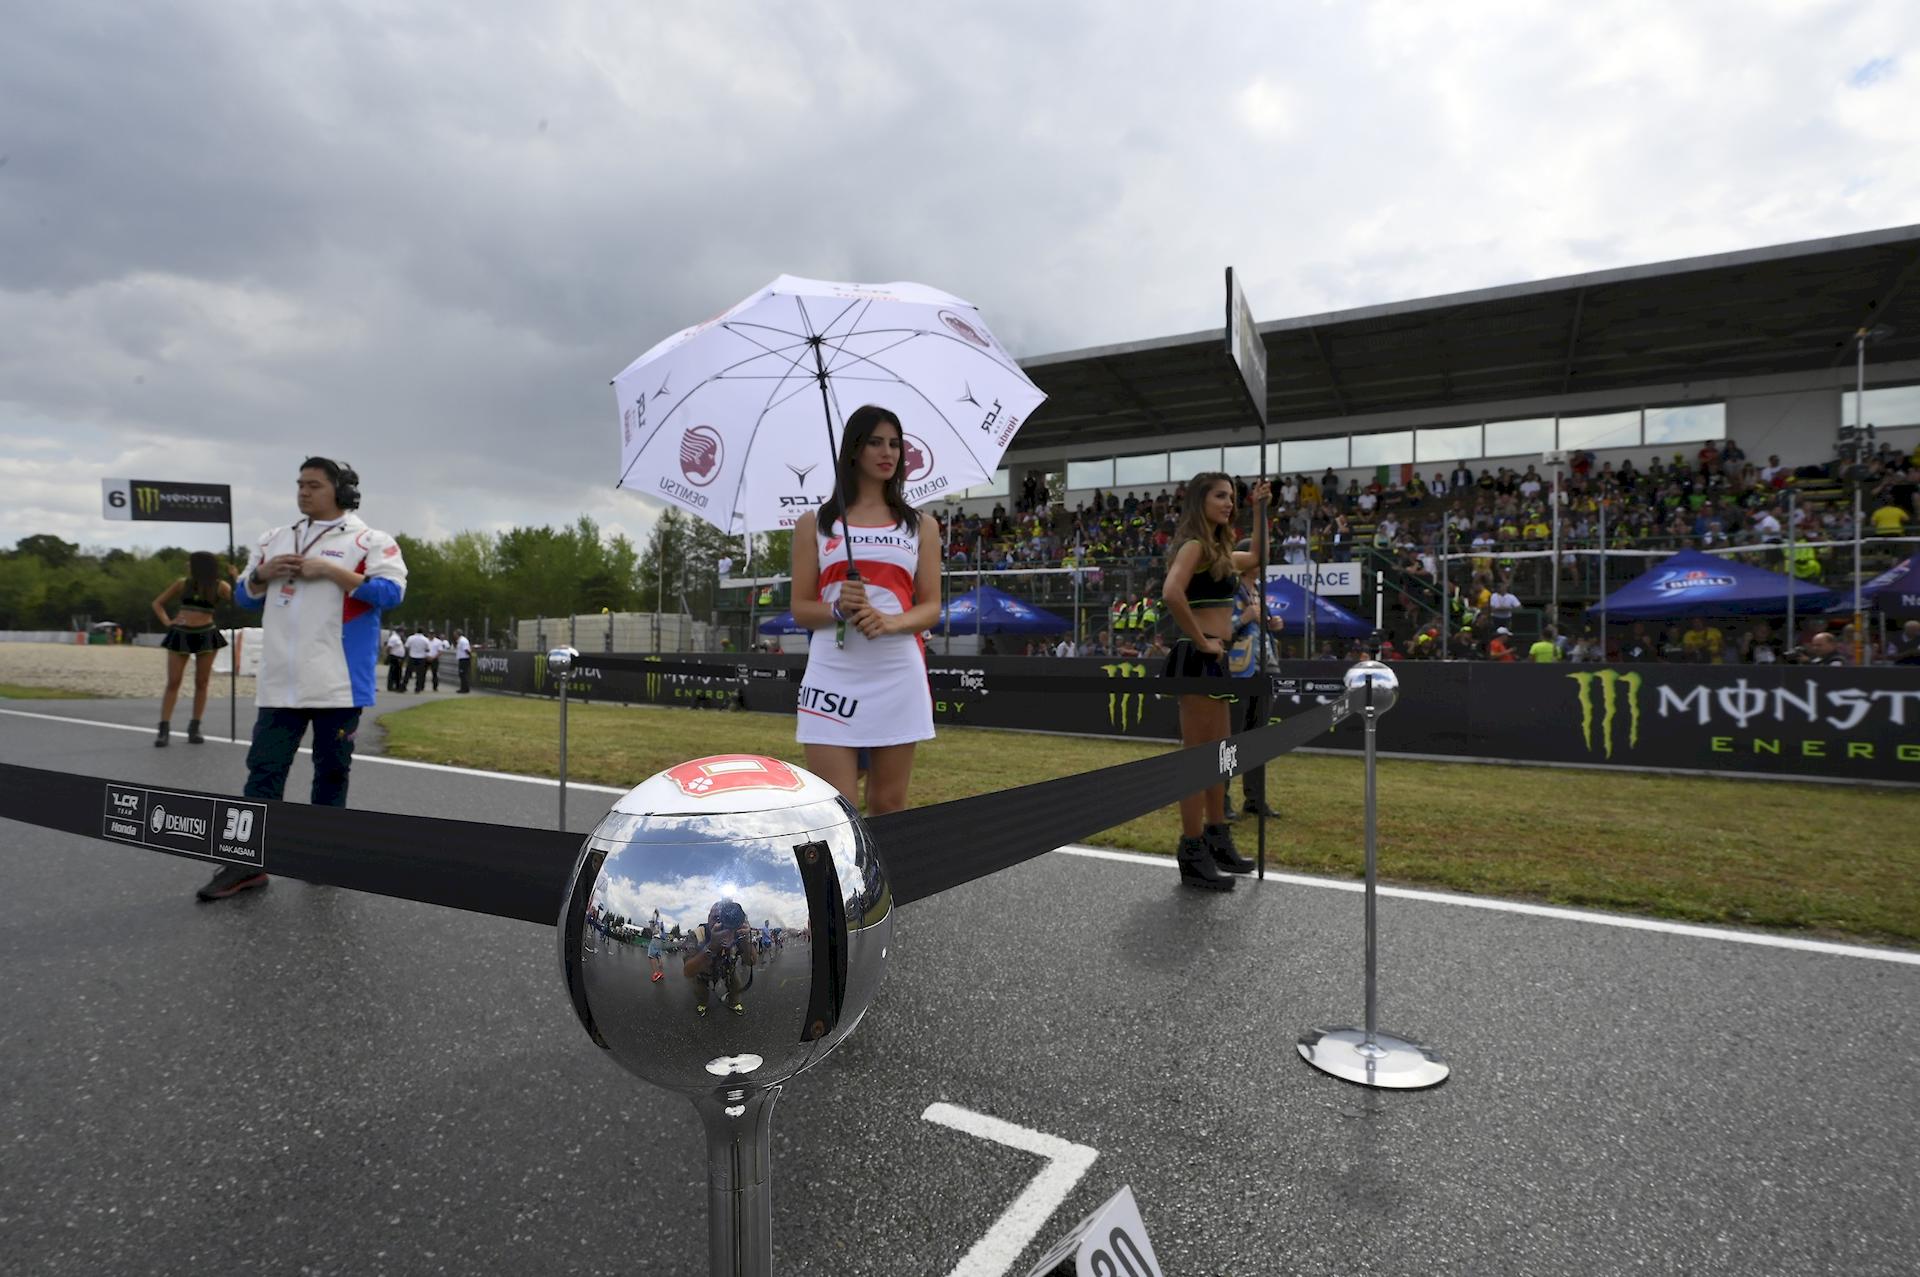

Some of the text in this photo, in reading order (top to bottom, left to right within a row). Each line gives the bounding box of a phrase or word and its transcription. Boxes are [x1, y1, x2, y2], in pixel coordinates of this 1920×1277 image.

[108, 490, 127, 508] 6
[112, 793, 139, 811] LCR
[117, 807, 134, 816] TEAM
[110, 821, 138, 836] Honda
[165, 814, 207, 836] IDEMITSU
[222, 807, 254, 843] 30
[219, 843, 256, 858] NAKAGAMI
